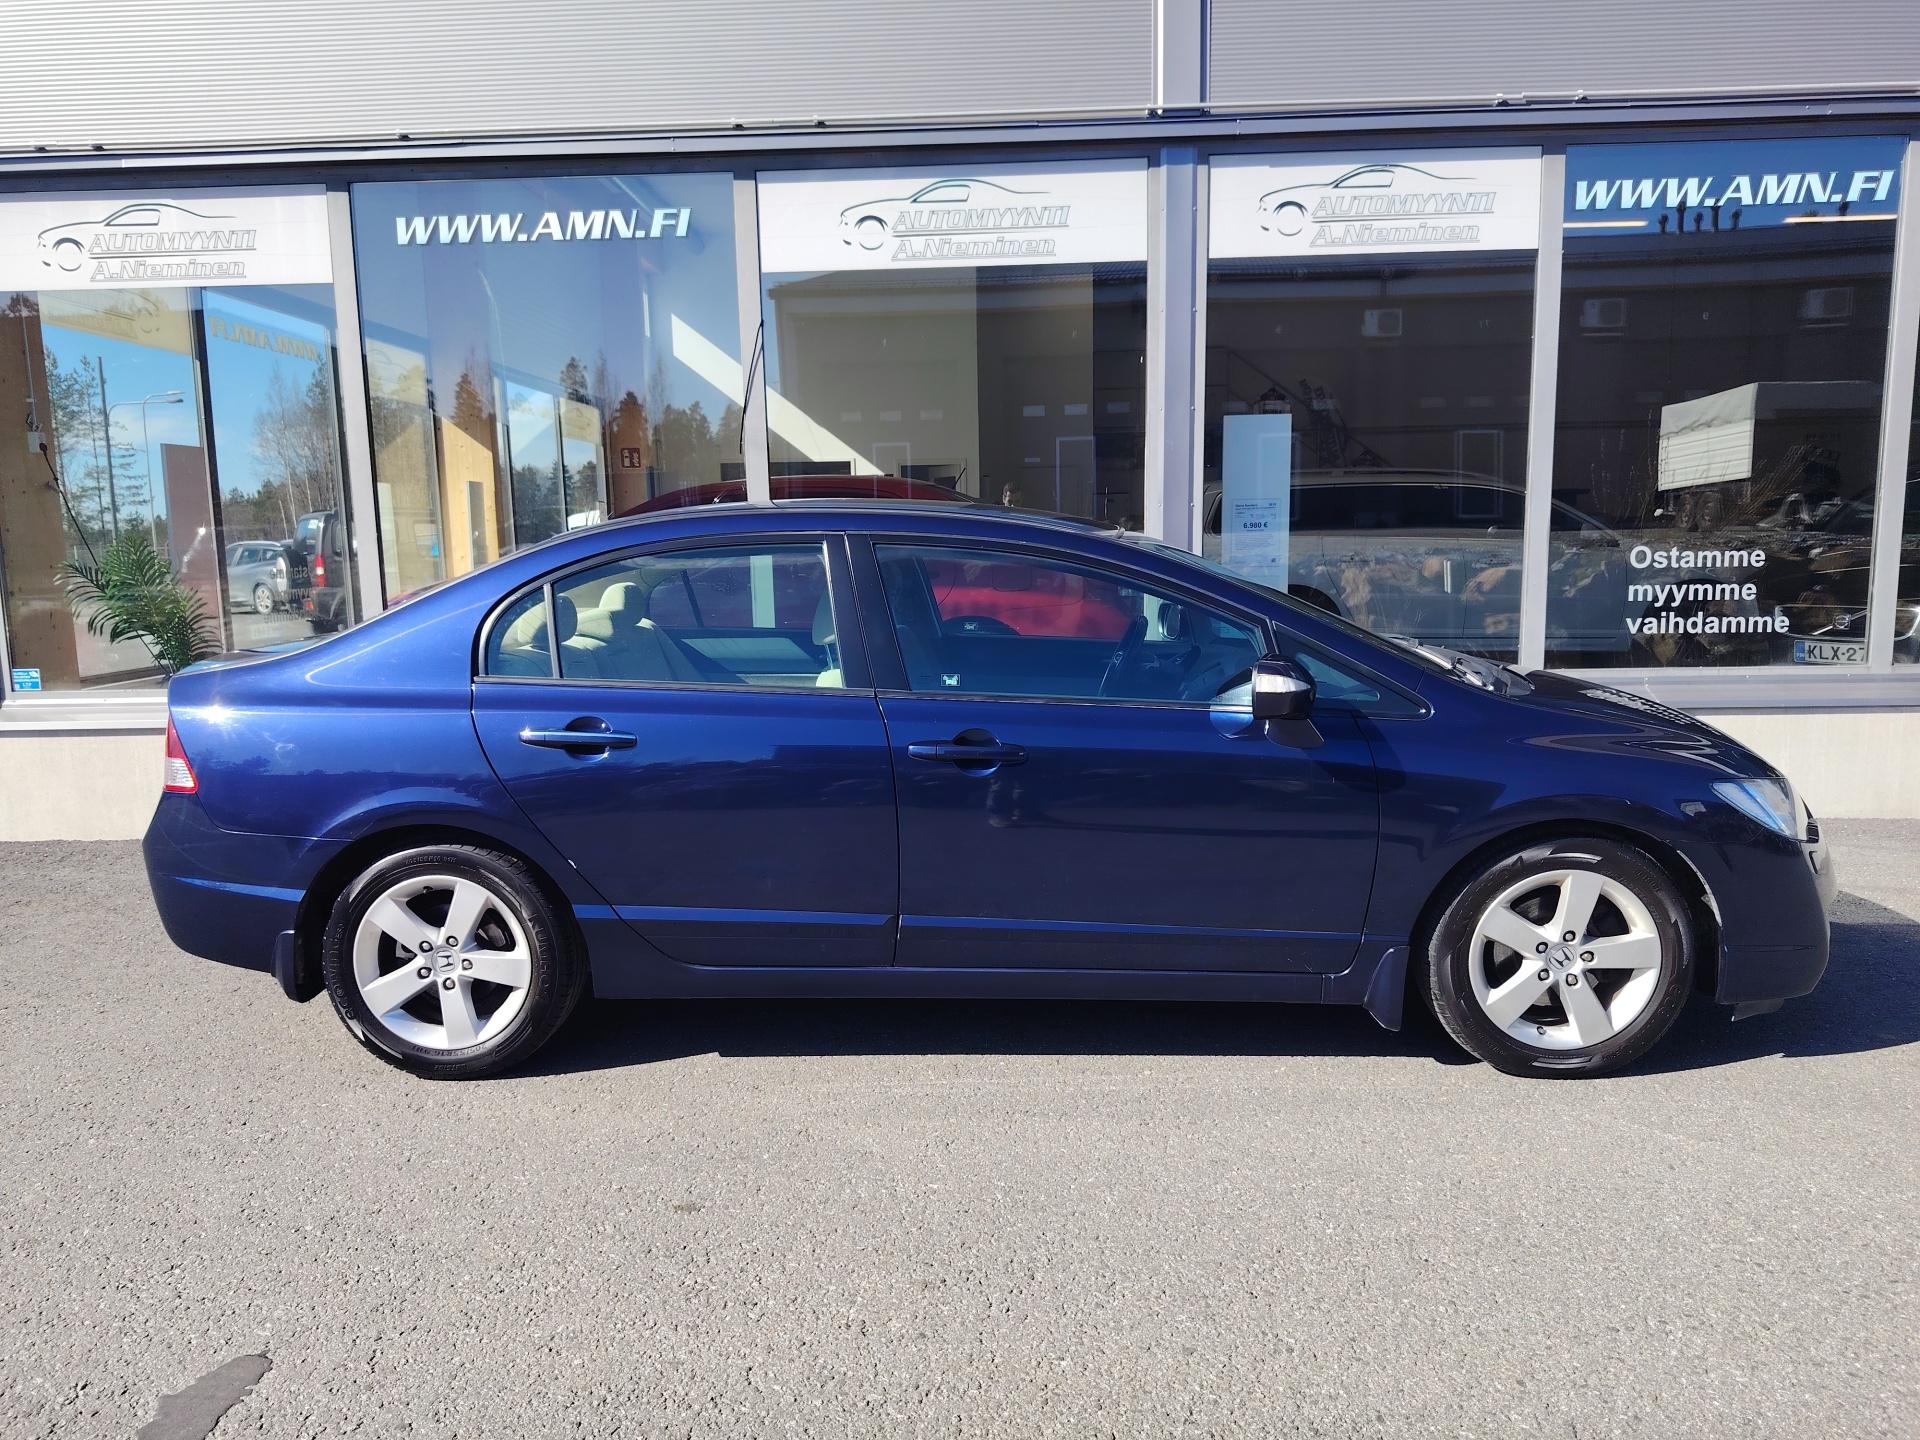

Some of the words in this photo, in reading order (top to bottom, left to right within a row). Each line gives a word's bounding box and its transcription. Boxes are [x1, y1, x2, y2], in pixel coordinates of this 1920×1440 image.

[1574, 169, 1896, 212] WWW.AMN.FI
[1311, 191, 1497, 217] AUTOMYYNTI
[395, 207, 693, 246] WWW.AMN.FI
[891, 205, 1071, 231] AUTOMYYNTI
[88, 229, 257, 253] AUTOMYYNTI
[1310, 222, 1481, 247] A.Nieminen
[892, 236, 1057, 261] A.Nieminen
[90, 258, 246, 281] A.Nieminen
[1629, 545, 1767, 569] Ostamme
[1627, 582, 1758, 608] myymme
[1625, 612, 1791, 636] vaihdamme
